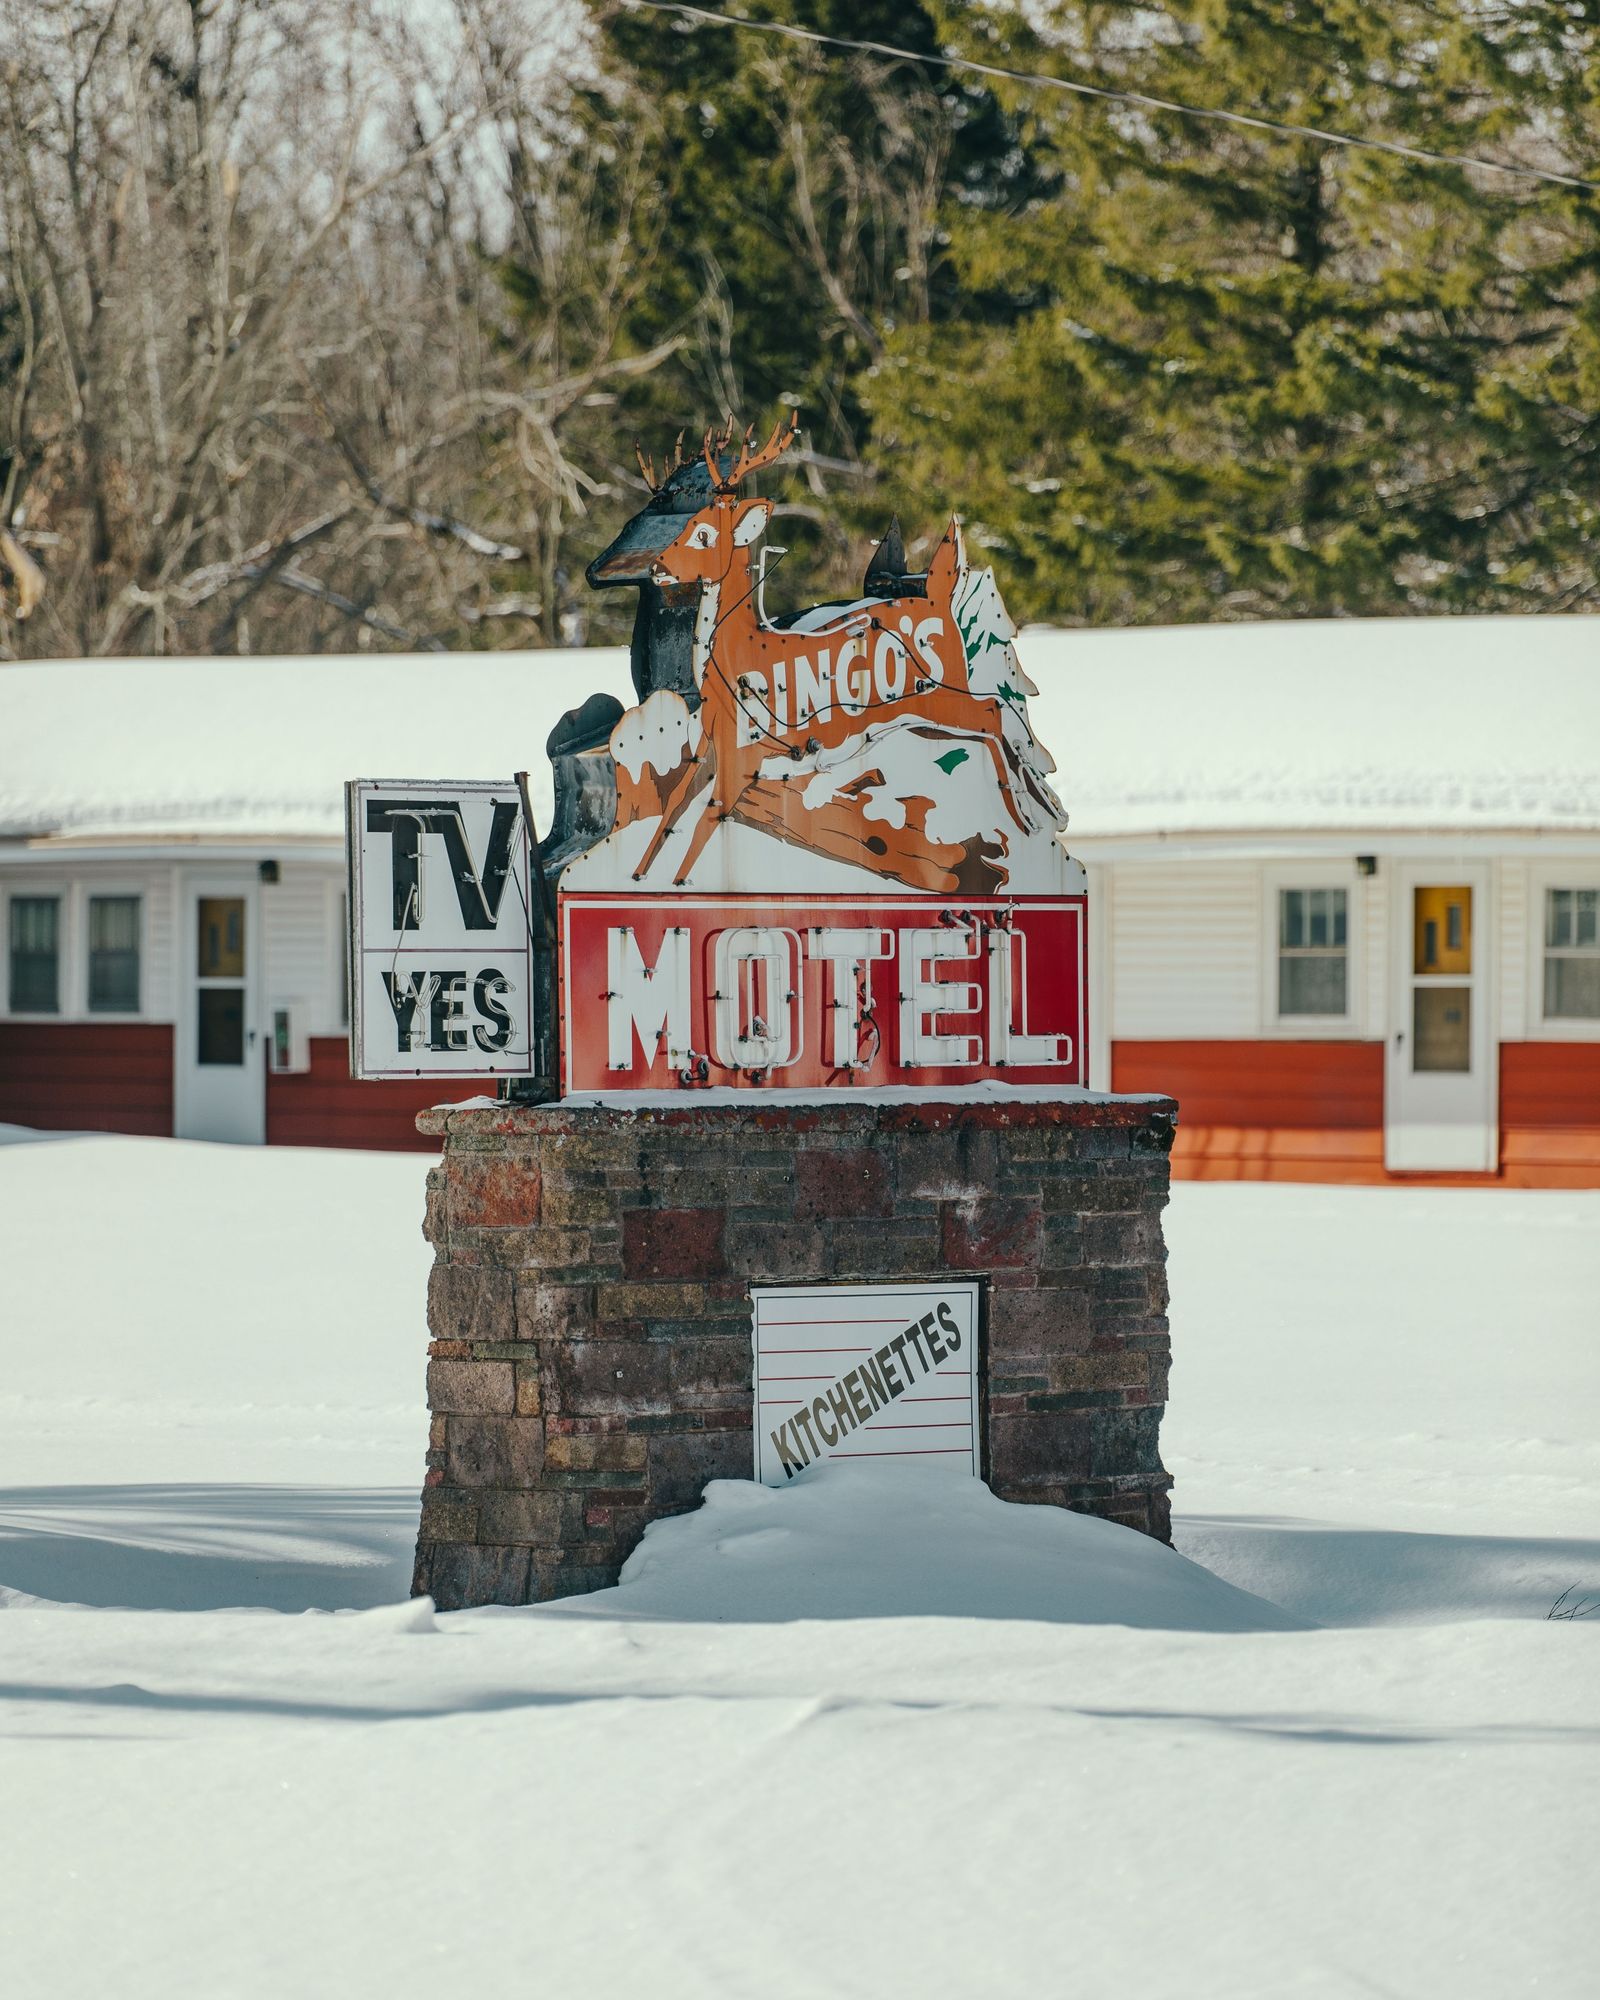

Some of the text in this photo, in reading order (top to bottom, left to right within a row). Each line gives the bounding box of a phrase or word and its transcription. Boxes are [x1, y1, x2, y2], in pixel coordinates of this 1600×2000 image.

[736, 615, 944, 748] BINGO'S
[366, 799, 522, 930] TV
[381, 968, 516, 1053] YES
[607, 926, 1072, 1071] MOTEL
[770, 1301, 962, 1480] KITCHENETTES
